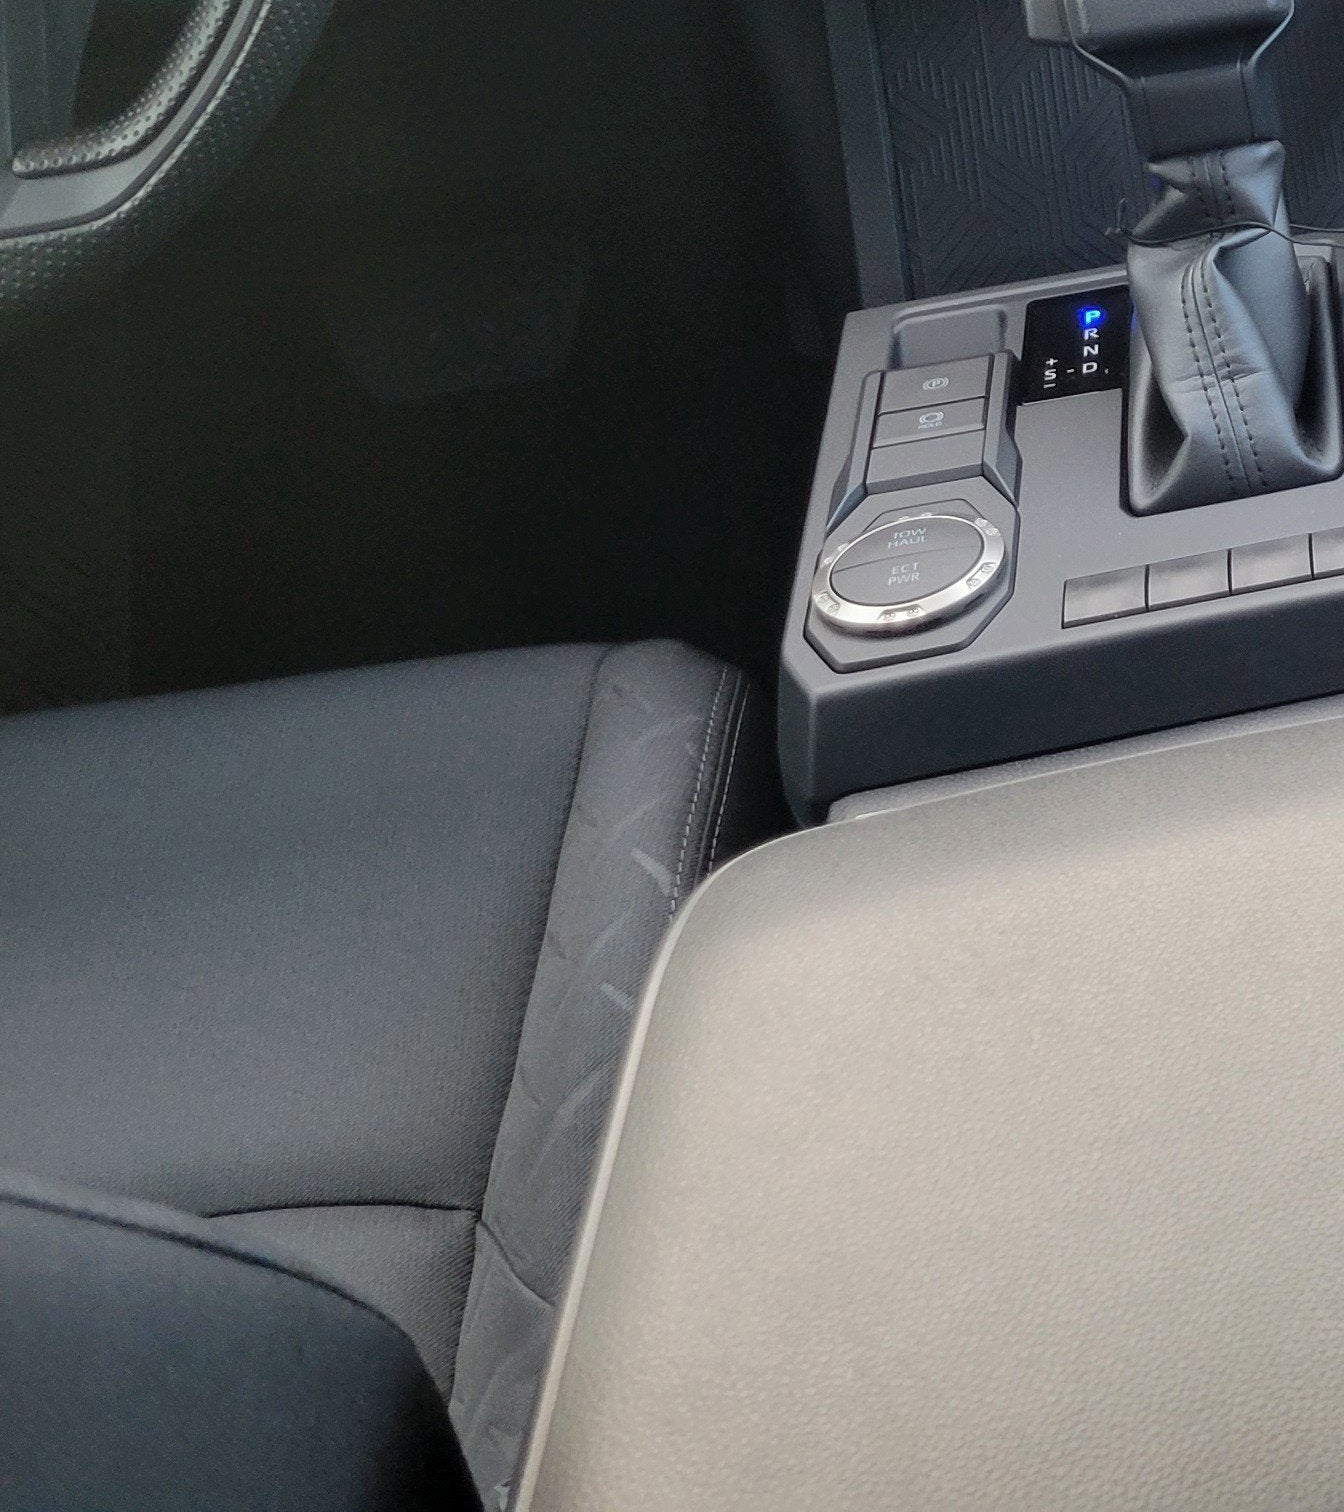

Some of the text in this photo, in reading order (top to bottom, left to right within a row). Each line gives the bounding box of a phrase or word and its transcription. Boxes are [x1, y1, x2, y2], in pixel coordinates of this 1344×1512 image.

[1085, 310, 1101, 325] P
[1084, 327, 1100, 341] R
[1083, 344, 1099, 357] N
[1082, 361, 1098, 374] D
[893, 527, 927, 539] TOW
[888, 535, 927, 549] HAUL
[892, 562, 919, 575] ECT
[888, 572, 920, 587] PWR
